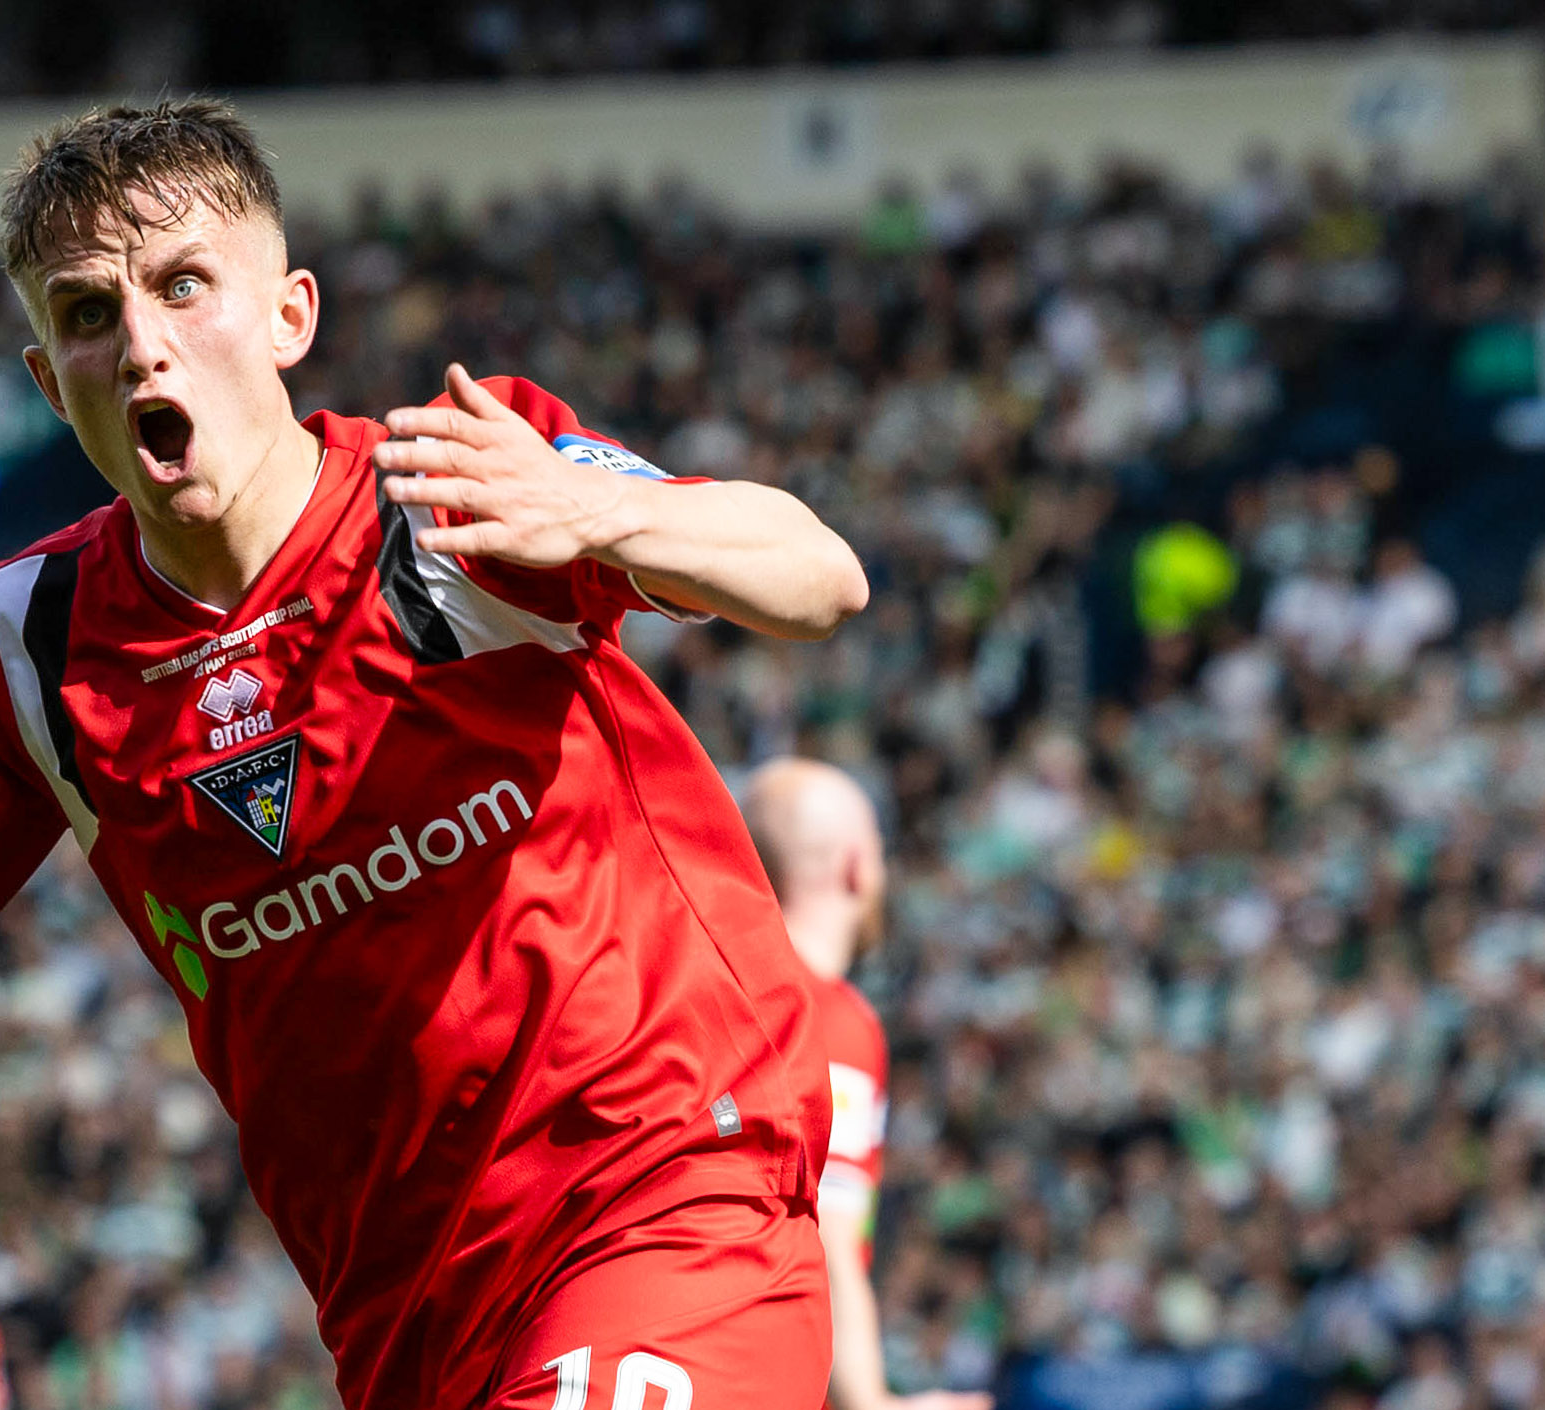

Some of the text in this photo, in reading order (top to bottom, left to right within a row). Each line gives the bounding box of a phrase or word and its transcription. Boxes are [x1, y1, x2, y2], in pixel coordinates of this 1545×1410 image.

[141, 658, 181, 683] SCOTTISH
[181, 649, 200, 669] GAS
[219, 616, 266, 648] SCOTTISH
[265, 607, 288, 627] CUP
[287, 597, 315, 619] FINAL
[204, 653, 227, 676] MAY
[201, 779, 534, 959] Gamdom
